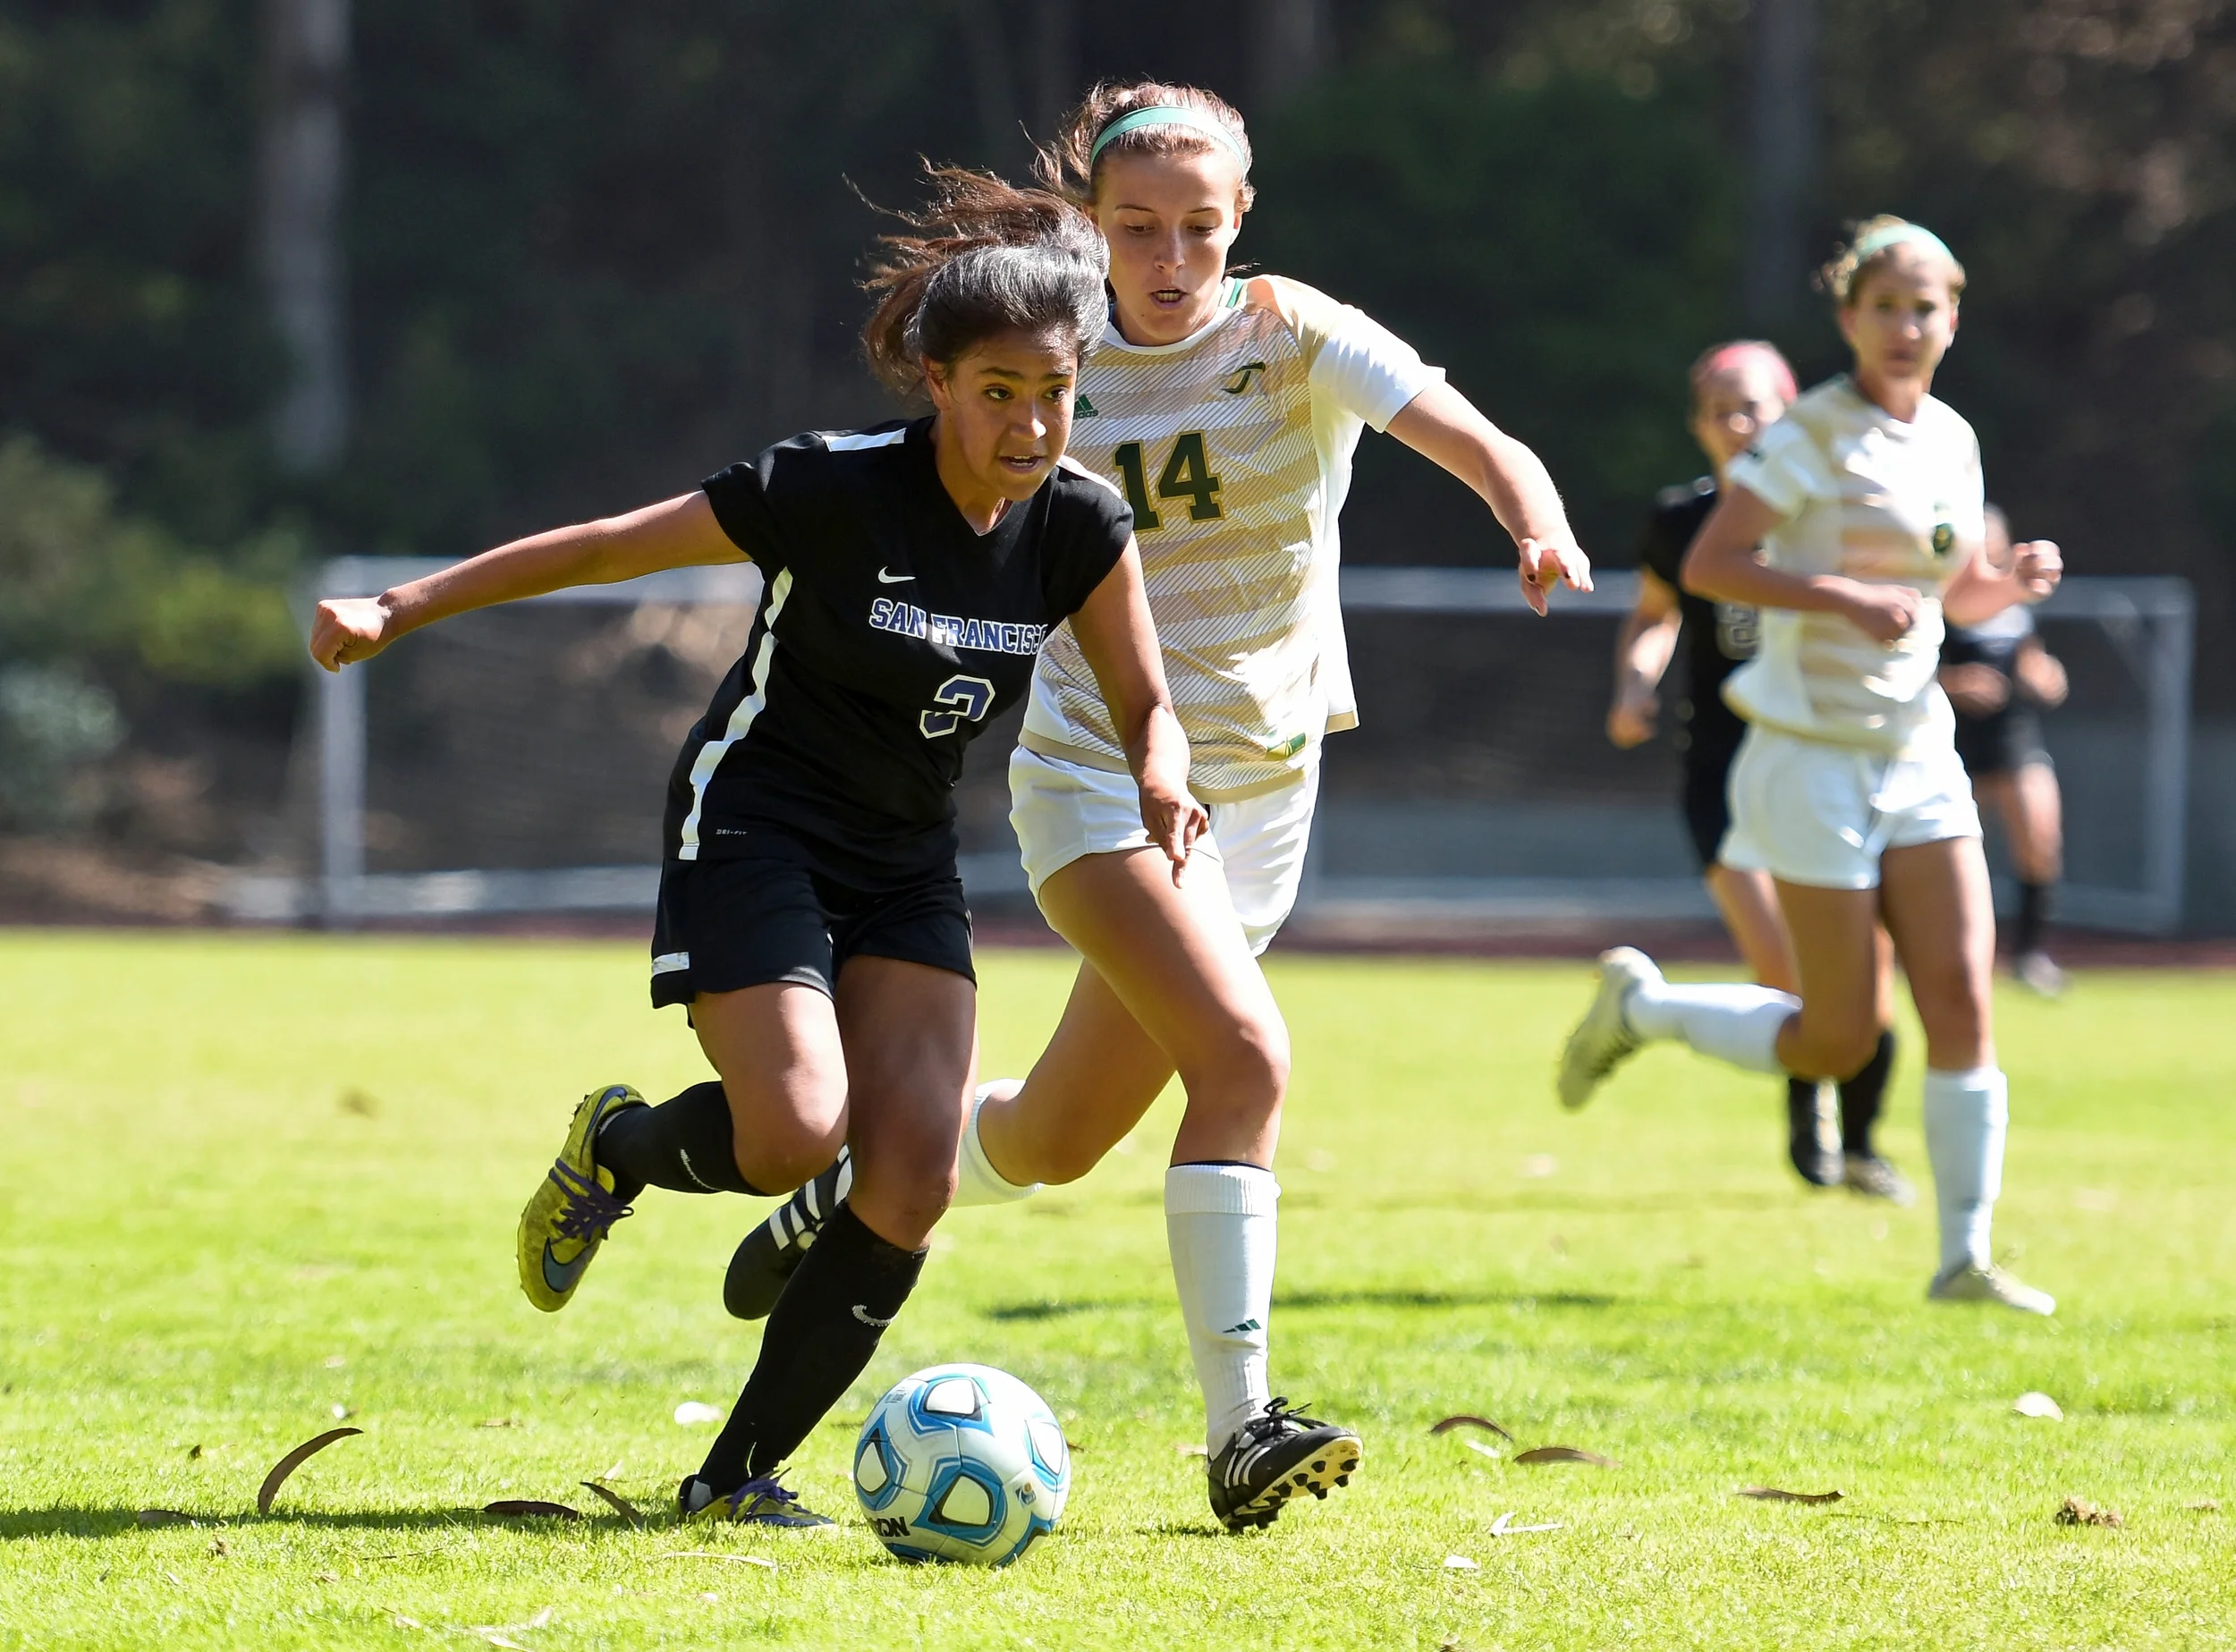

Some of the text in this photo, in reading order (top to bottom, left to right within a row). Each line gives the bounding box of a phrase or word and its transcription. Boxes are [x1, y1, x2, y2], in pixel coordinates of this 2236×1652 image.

[1073, 408, 1099, 420] idas
[1113, 430, 1225, 533] 14
[868, 597, 927, 640] SAN
